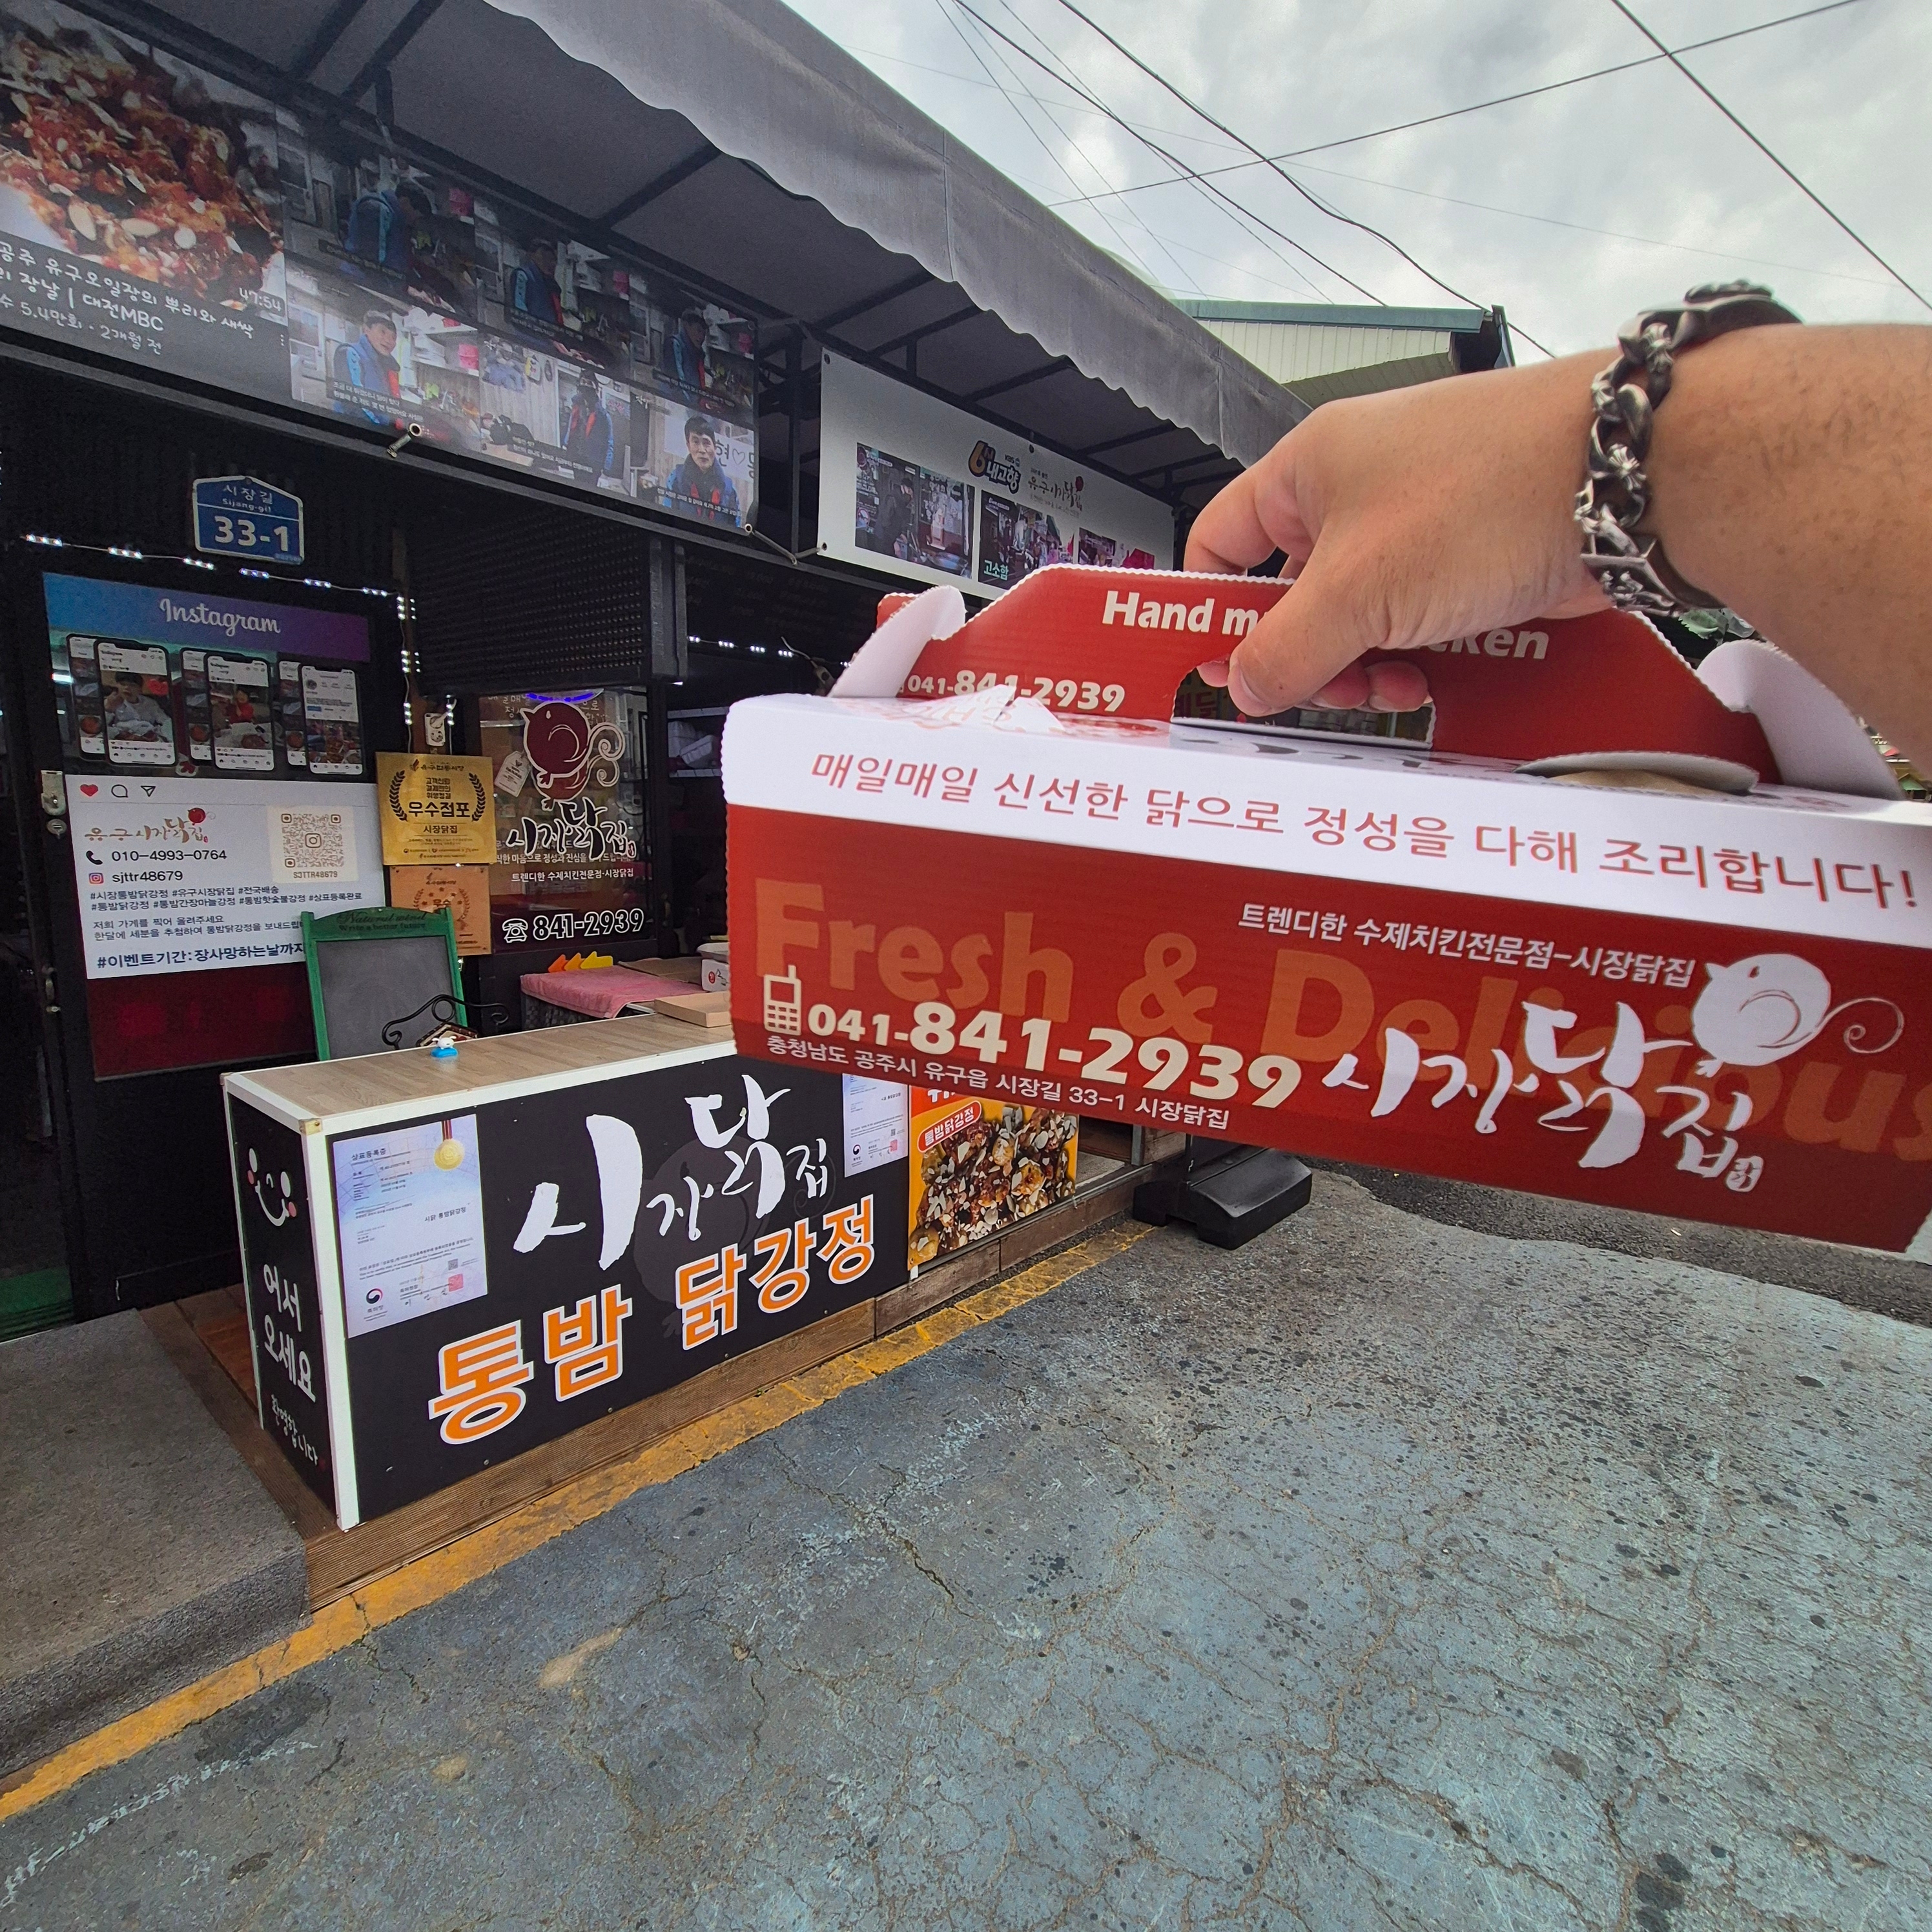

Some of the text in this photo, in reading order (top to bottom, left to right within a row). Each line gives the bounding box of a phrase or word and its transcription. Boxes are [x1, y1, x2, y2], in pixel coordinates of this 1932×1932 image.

[19, 272, 61, 301] 장날
[82, 294, 164, 331] 대전MBC
[45, 258, 158, 305] 유구오일장의
[165, 295, 216, 324] 뿌리와
[239, 287, 282, 312] 47:54
[20, 302, 82, 329] 5.4만회
[101, 325, 141, 351] 2개월
[147, 338, 161, 355] 전
[223, 485, 272, 504] 시장길
[987, 461, 1021, 494] 내고향
[222, 498, 271, 513] Sijang-gil
[215, 517, 288, 551] 33-1
[983, 559, 1009, 581] 고소함
[159, 598, 281, 637] Instagram
[1102, 590, 1215, 633] Hand
[1222, 608, 1266, 636] m
[408, 801, 471, 817] 우수점포
[423, 825, 458, 834] 시장닭집
[506, 796, 628, 861] 시장닭집
[811, 754, 1918, 910] 매일매일 신선한 닭으로 정성을 다해 조리합니다!
[112, 850, 227, 861] 010-4993-0764
[511, 854, 542, 864] 마음으로
[543, 854, 564, 863] 정성과
[566, 854, 586, 863] 진심을
[112, 870, 183, 884] sjttr48679
[511, 868, 634, 882] 트렌디한 수제치킨전문점-시장닭집
[90, 885, 279, 900] #시장통밤닭강정 #유구시장닭집 #전국배송
[91, 901, 149, 912] #통밤닭강정
[154, 898, 235, 909] #통밤간장마늘강정
[309, 892, 362, 902] #상표등록완료
[93, 921, 114, 929] 저희
[118, 919, 148, 929] 가게를
[177, 915, 224, 926] 올려주세요
[95, 931, 126, 941] 한달에
[130, 929, 159, 938] 세분을
[164, 927, 202, 936] 추첨하여
[206, 923, 261, 934] 통밤닭강정을
[533, 908, 644, 941] 841-2939
[755, 878, 1074, 1023] Fresh
[1117, 932, 1218, 1044] &
[1238, 903, 1696, 989] 트렌디한 수제치킨전문점-시장닭집
[807, 1001, 1302, 1109] 041-841-2939
[767, 1036, 1229, 1130] 충청남도 공주시 유구읍 시장길 33-1 시장닭집
[1322, 1000, 1754, 1178] 시장닭집
[925, 1107, 974, 1146] 통밤닭강정
[351, 1147, 387, 1161] 상표등록증
[513, 1074, 828, 1270] 시장닭집
[263, 1264, 302, 1332] 어서
[429, 1194, 874, 1445] 통밤 닭강정
[264, 1315, 316, 1403] 오세요
